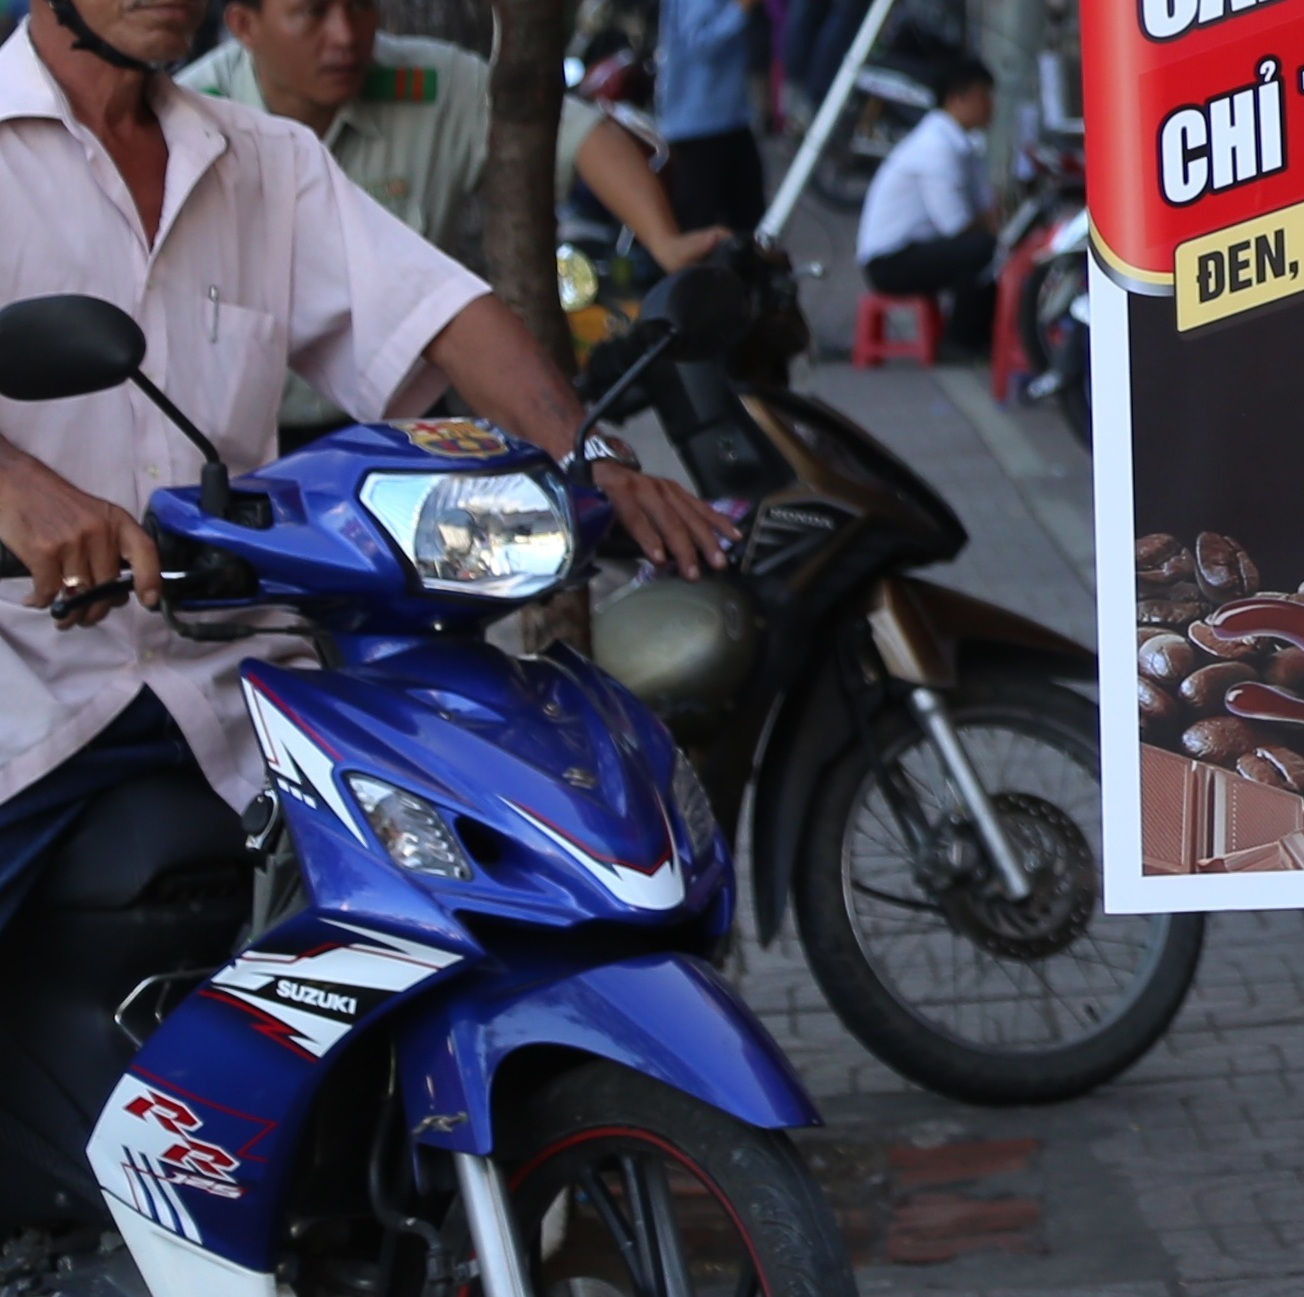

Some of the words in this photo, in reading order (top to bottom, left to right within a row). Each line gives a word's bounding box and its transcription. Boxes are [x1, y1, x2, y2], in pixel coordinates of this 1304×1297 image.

[1160, 59, 1285, 204] CHỈ
[1195, 228, 1300, 305] ĐEN,
[275, 979, 358, 1015] SUZUKI
